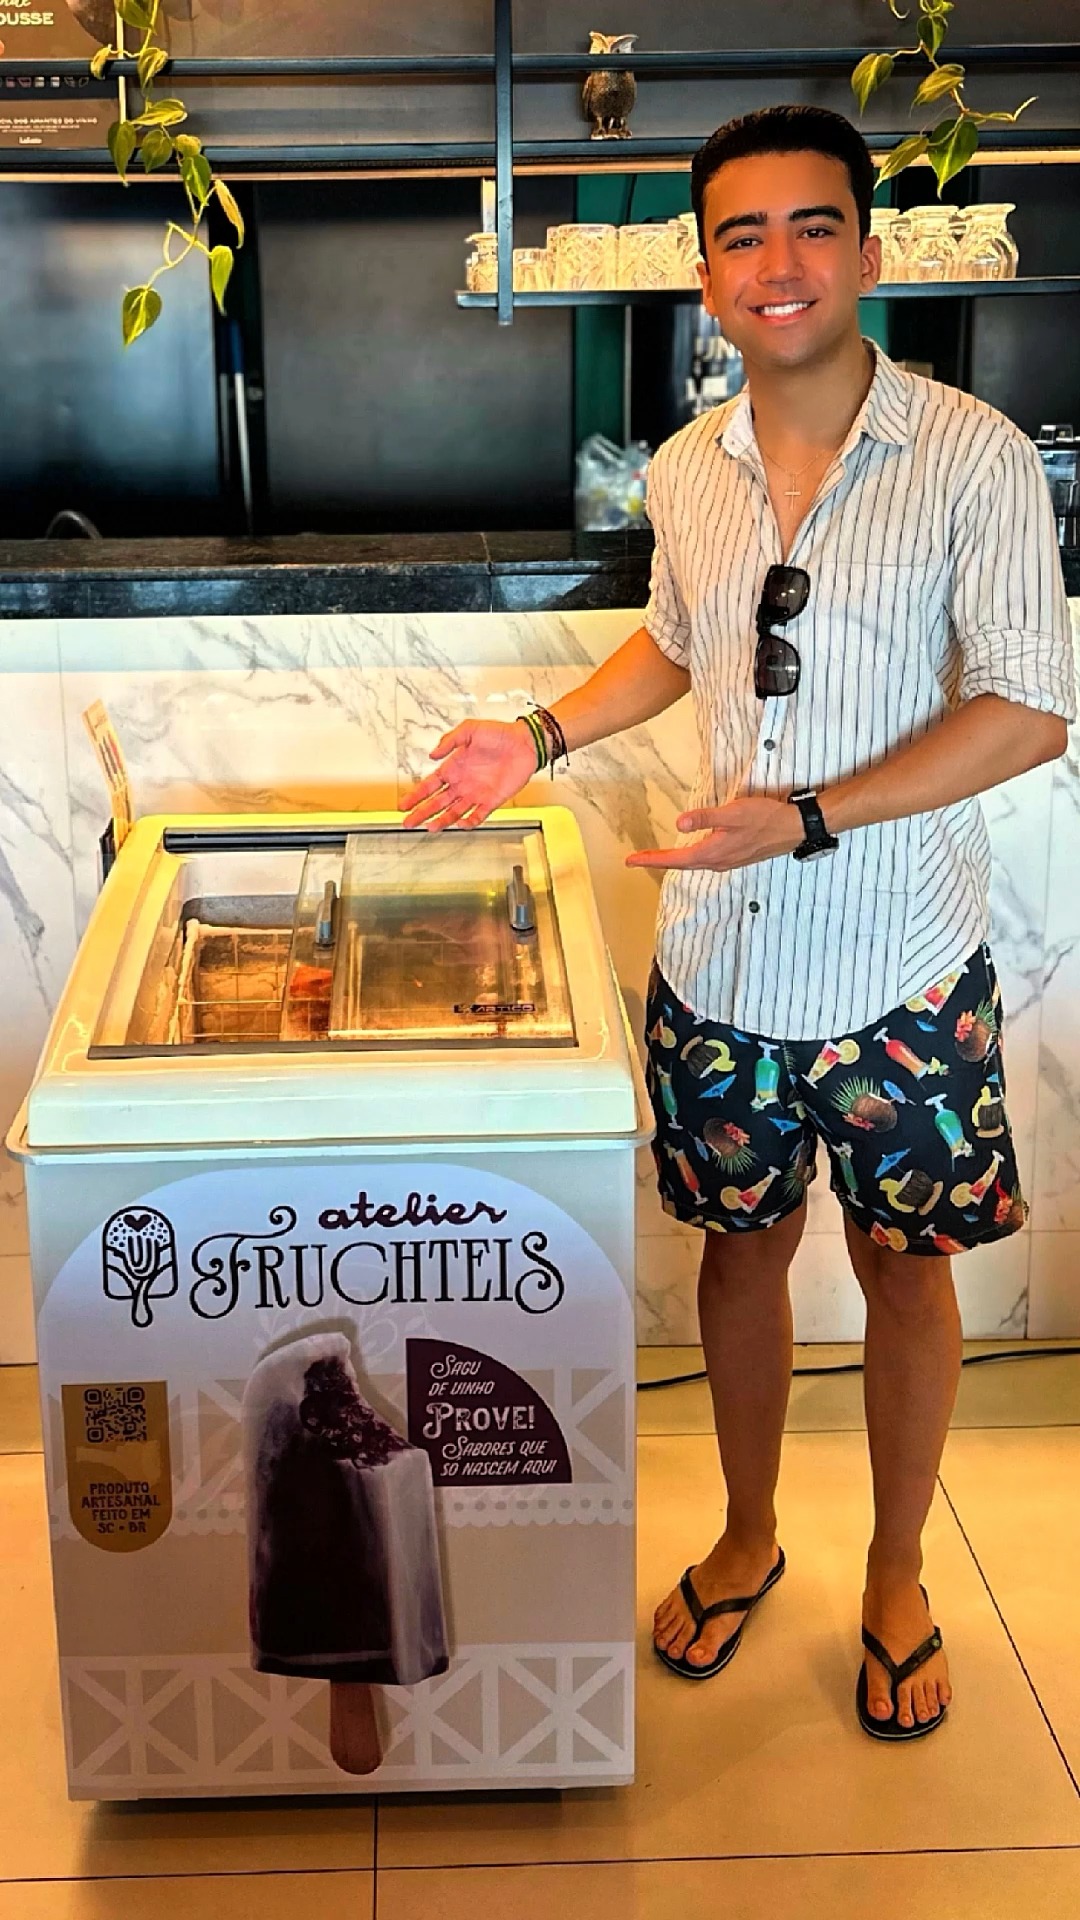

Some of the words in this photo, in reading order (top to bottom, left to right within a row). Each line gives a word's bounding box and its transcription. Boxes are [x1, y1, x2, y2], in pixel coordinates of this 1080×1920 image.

[318, 1191, 507, 1230] atelier
[190, 1206, 564, 1319] FRUCHTEIS
[430, 1355, 482, 1379] SAGU
[429, 1382, 449, 1396] DE
[423, 1402, 535, 1439] PROVE!
[443, 1436, 516, 1459] SABORES
[519, 1440, 548, 1456] QUE
[461, 1461, 520, 1475] NASCEM
[521, 1460, 557, 1474] AQUI
[90, 1482, 149, 1495] PRODUTO
[81, 1494, 160, 1508] ARTESANAL
[92, 1508, 128, 1521] FEITO
[132, 1508, 150, 1520] EM
[97, 1523, 115, 1533] SC
[129, 1522, 146, 1533] BR
